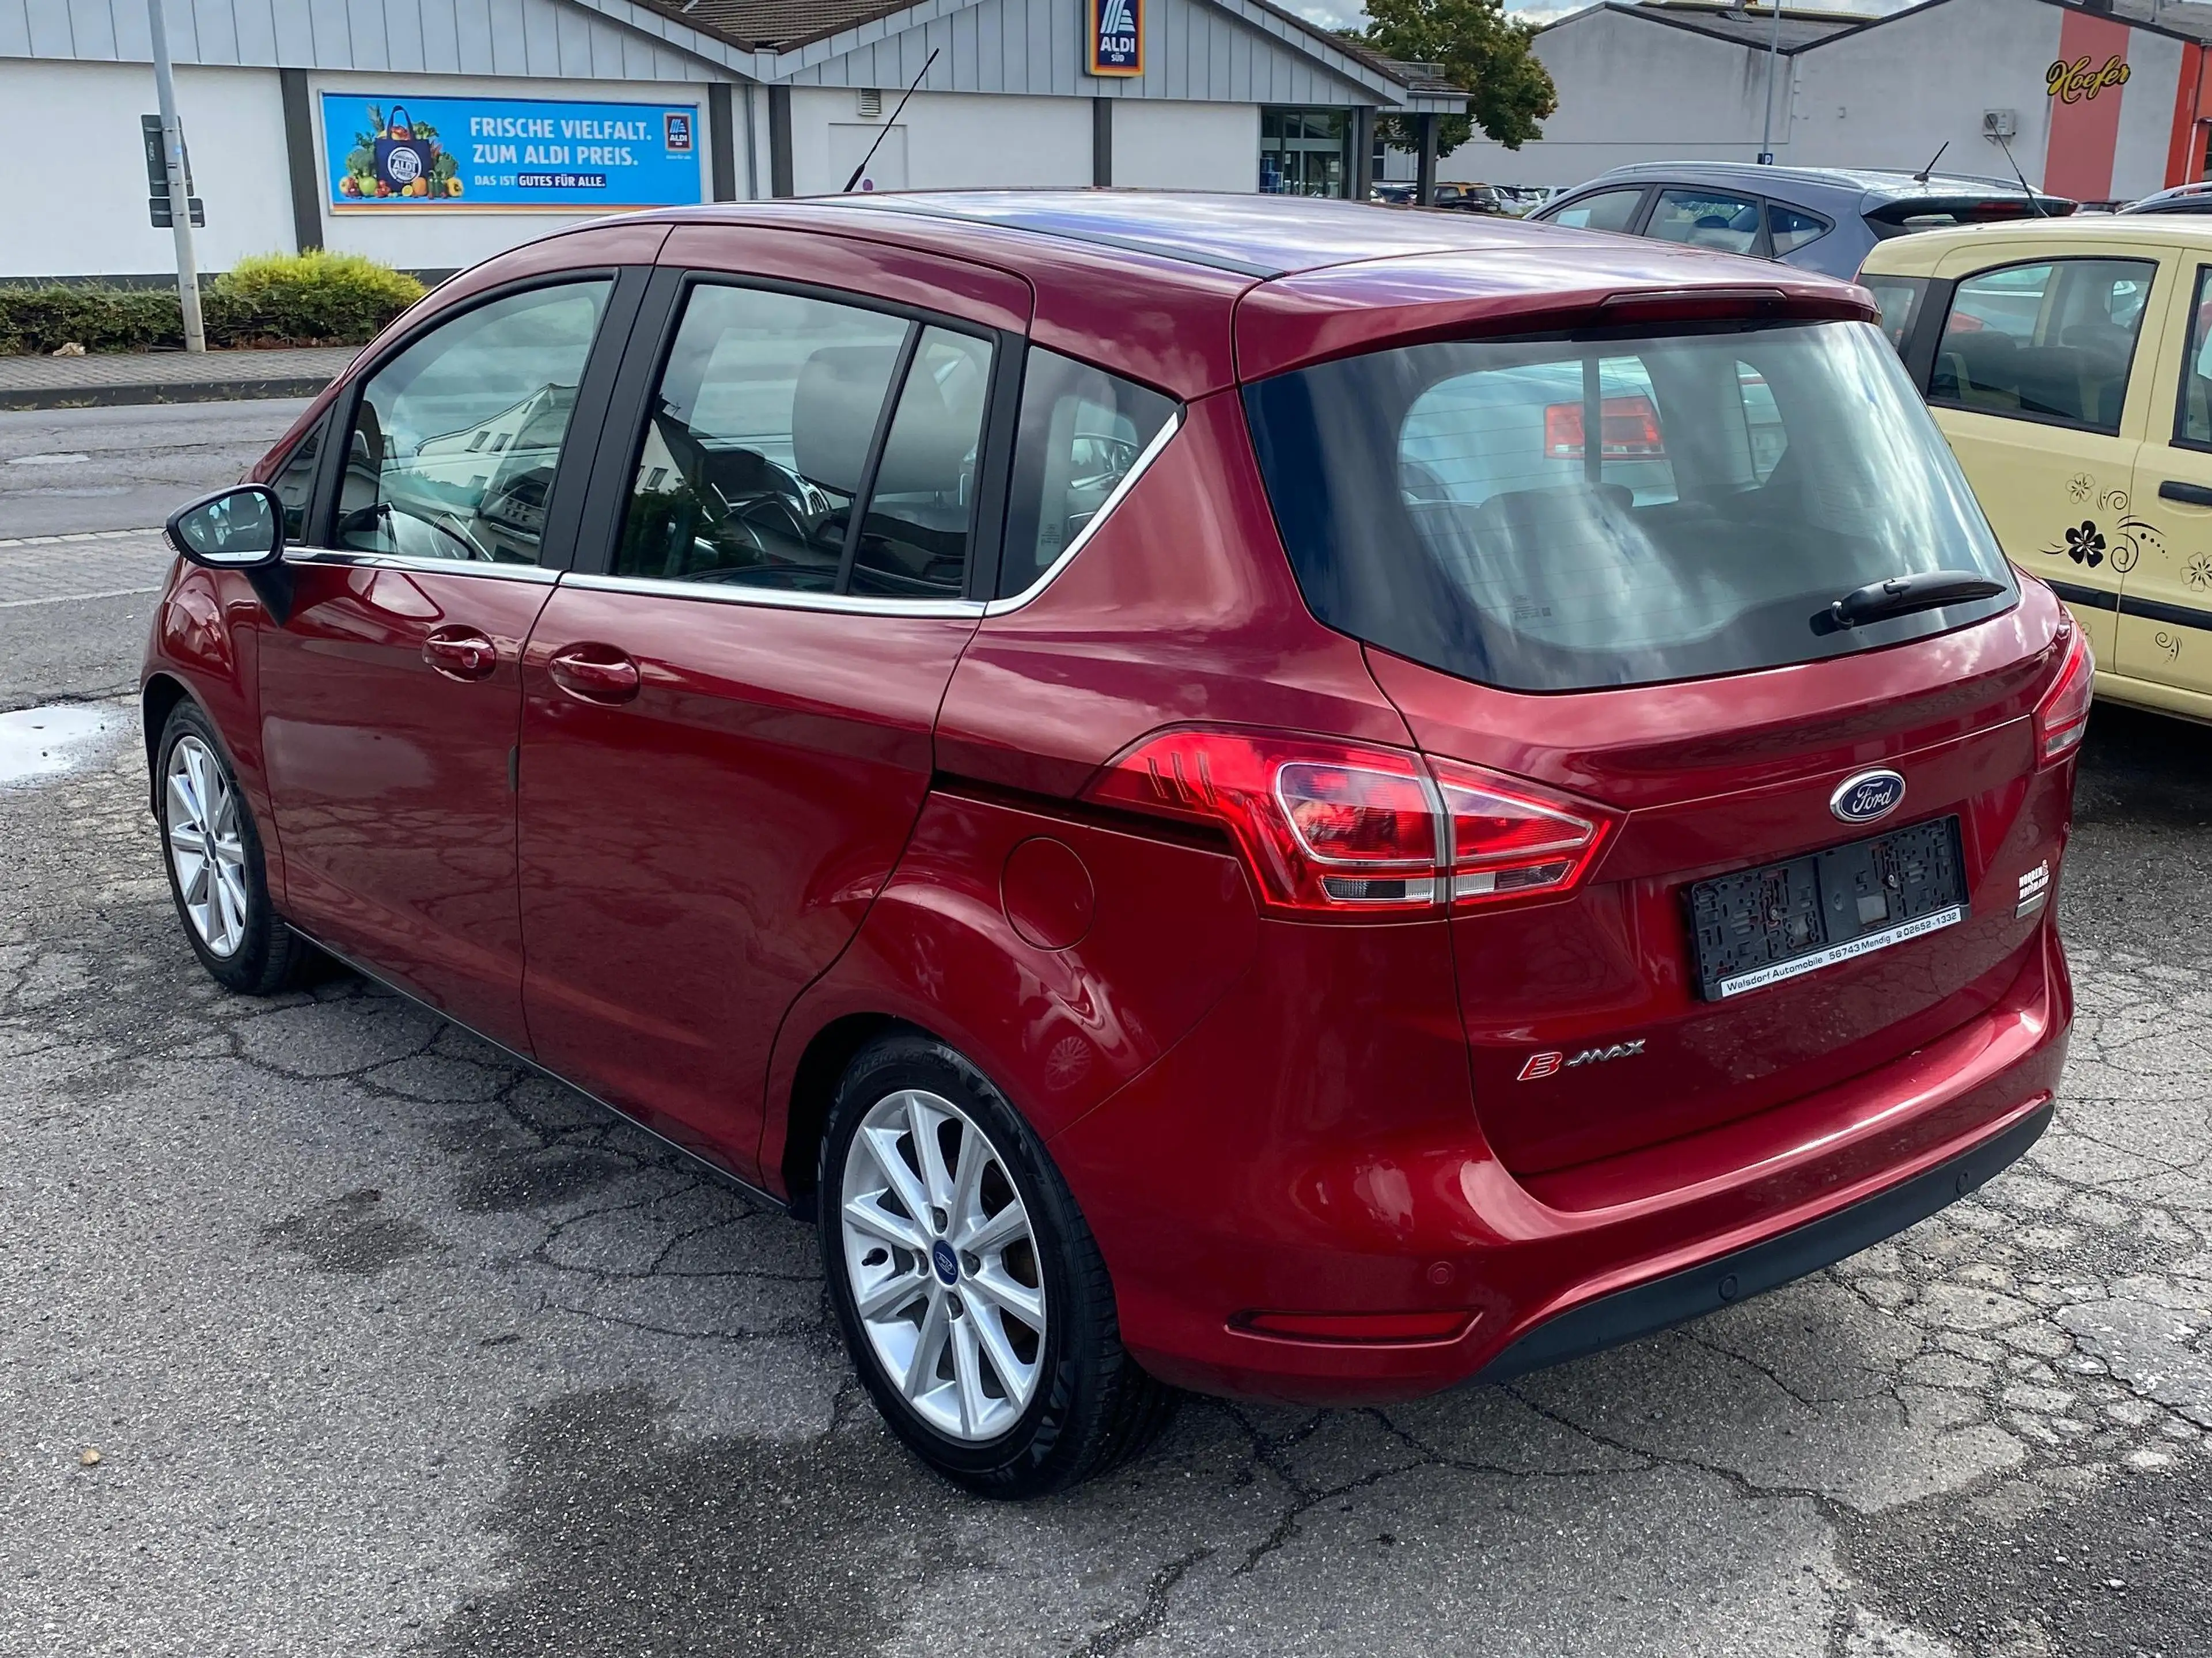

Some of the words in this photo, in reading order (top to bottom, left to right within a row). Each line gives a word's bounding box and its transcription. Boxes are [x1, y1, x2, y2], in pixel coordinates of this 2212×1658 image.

[1100, 36, 1135, 52] ALDI
[2046, 55, 2131, 104] Hoefer
[470, 117, 555, 138] FRISCHE
[560, 119, 652, 141] VIELFALT.
[393, 160, 415, 173] ALDI
[472, 144, 517, 164] ZUM
[524, 145, 570, 165] ALDI
[577, 146, 638, 166] PREIS.
[475, 175, 497, 186] DAS
[500, 176, 516, 186] IST
[519, 176, 552, 186] GUTES
[555, 174, 575, 187] FÜR
[578, 176, 605, 187] ALLE.
[1852, 781, 1893, 813] Ford
[1727, 972, 1770, 991] Walsdorf
[1772, 957, 1823, 978] Automobile
[1829, 944, 1859, 960] 56743
[1861, 935, 1891, 950] Mendig
